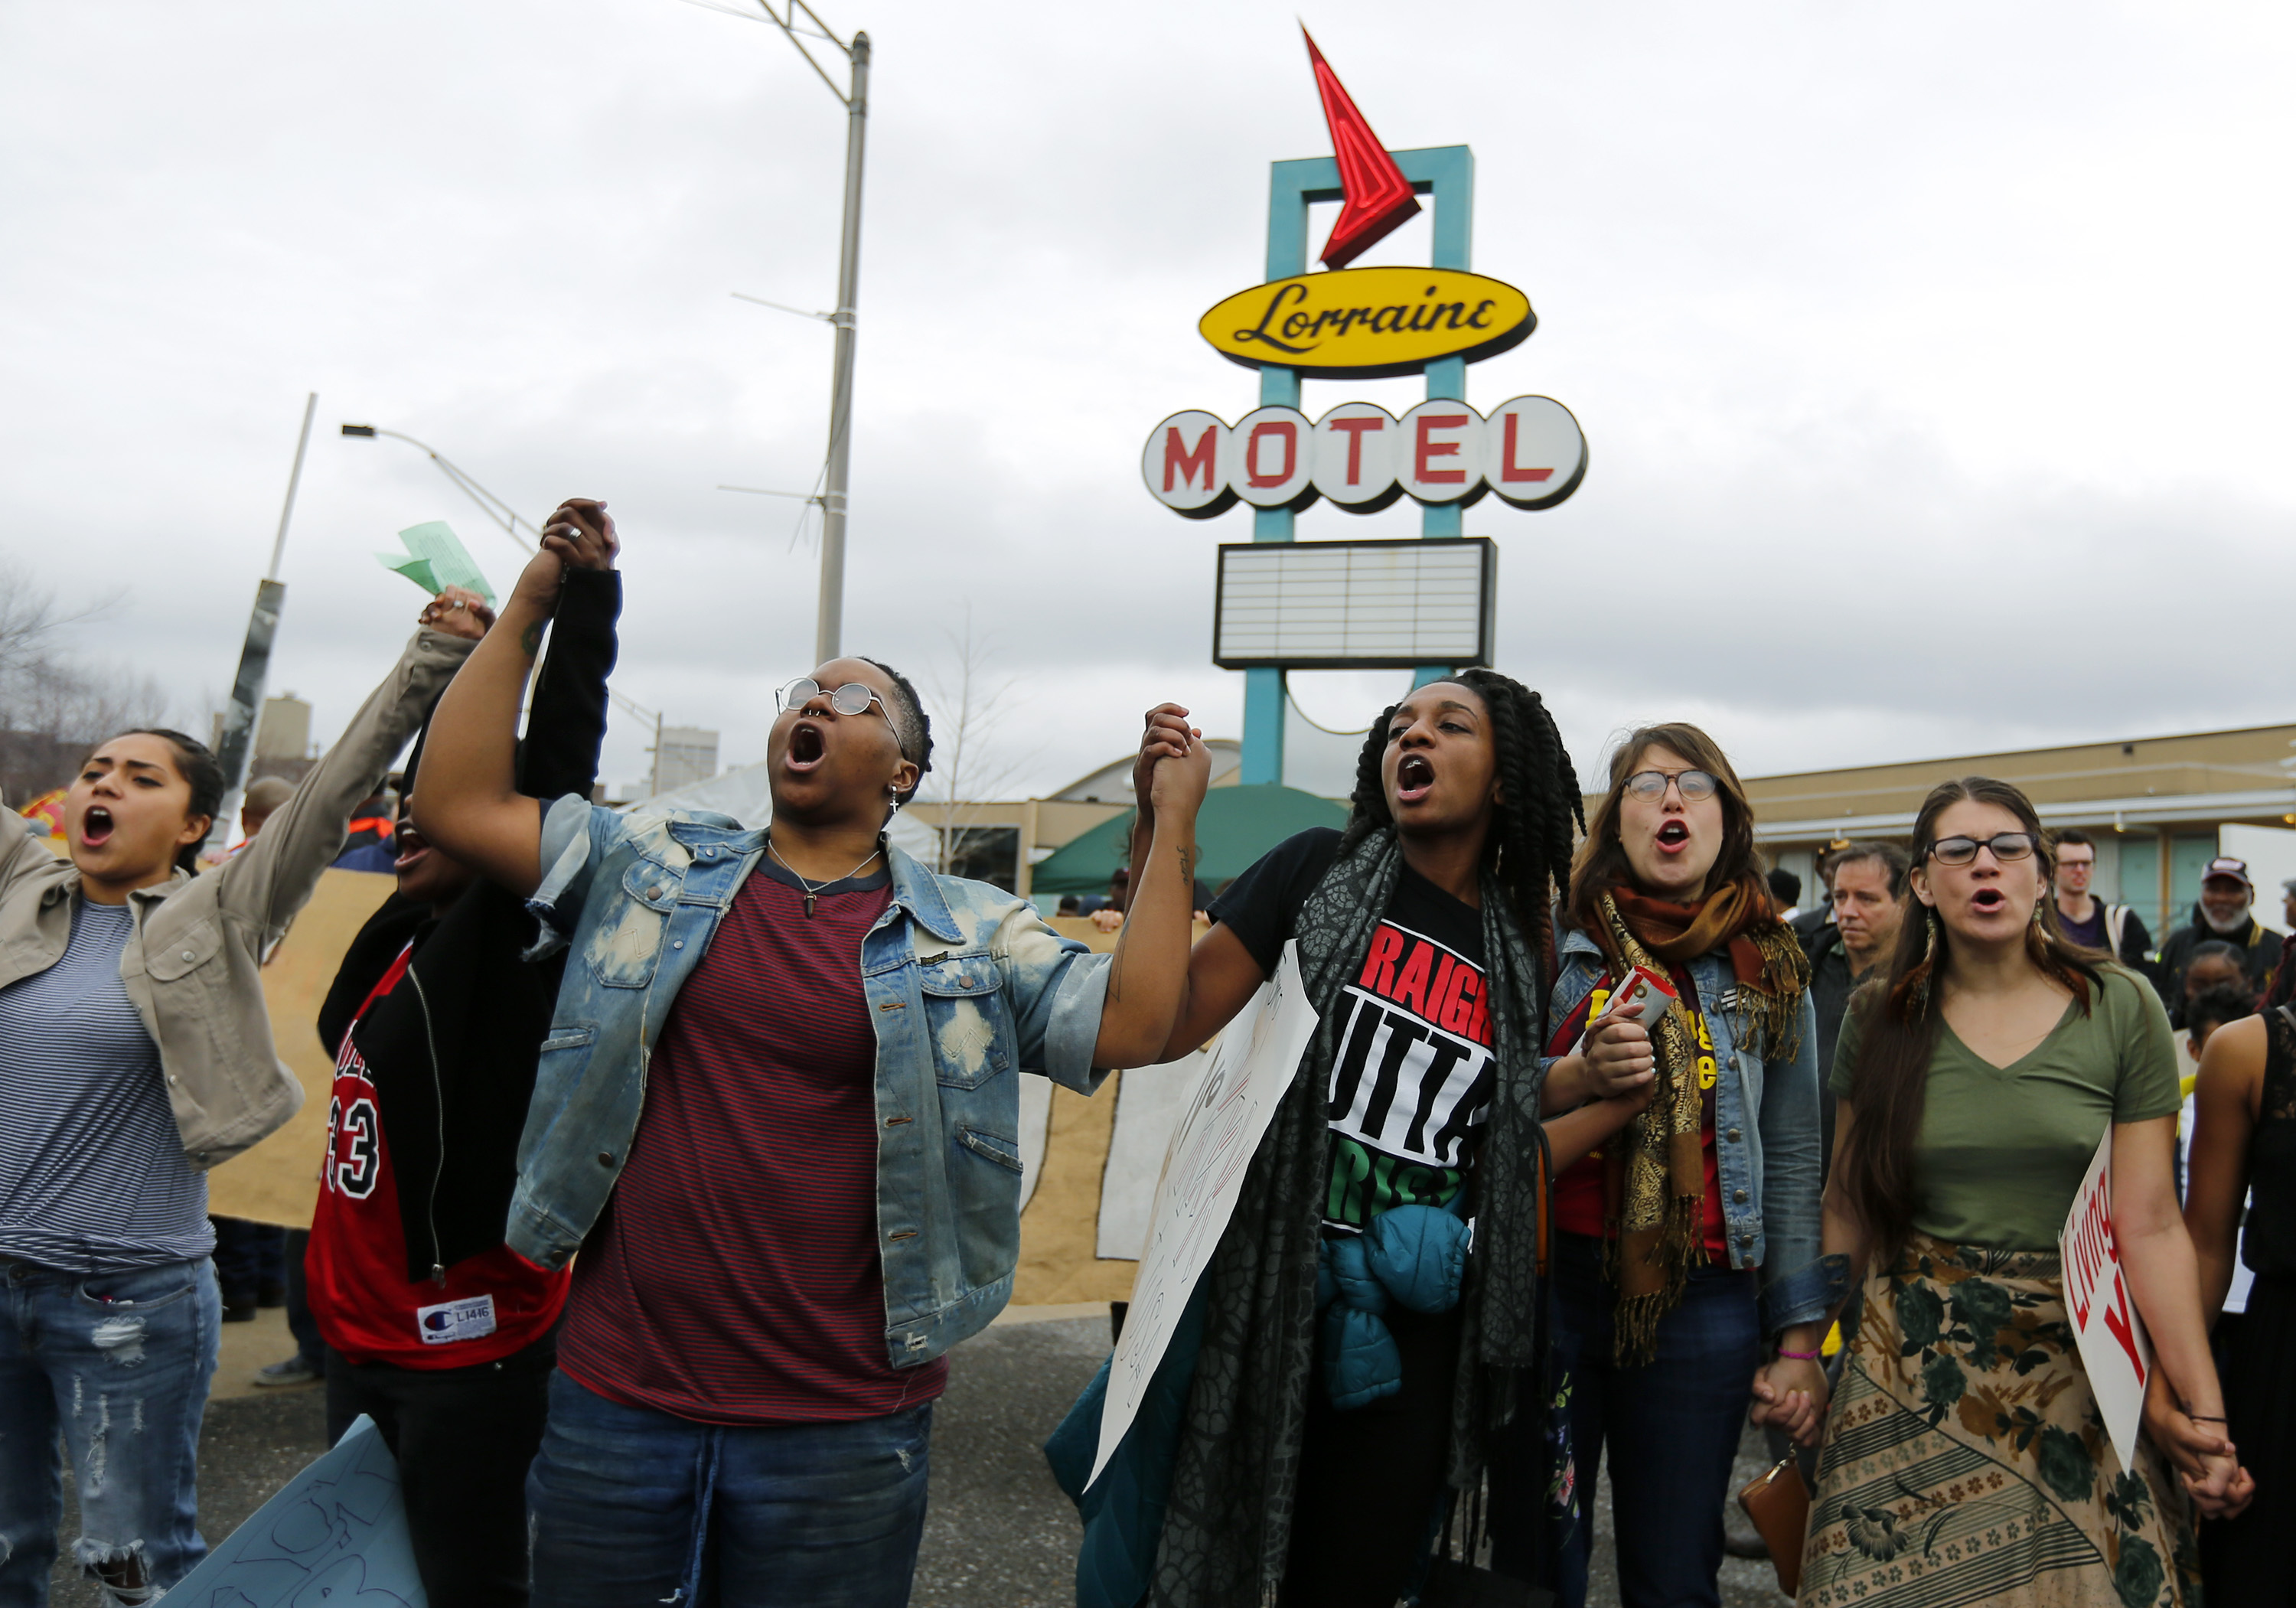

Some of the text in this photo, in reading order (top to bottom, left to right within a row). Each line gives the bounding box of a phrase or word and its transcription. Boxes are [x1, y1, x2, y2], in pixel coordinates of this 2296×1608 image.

[1234, 284, 1495, 354] Lorraine
[1163, 413, 1554, 492] MOTEL
[2065, 1166, 2118, 1335] Living
[1120, 1254, 1165, 1409] USA
